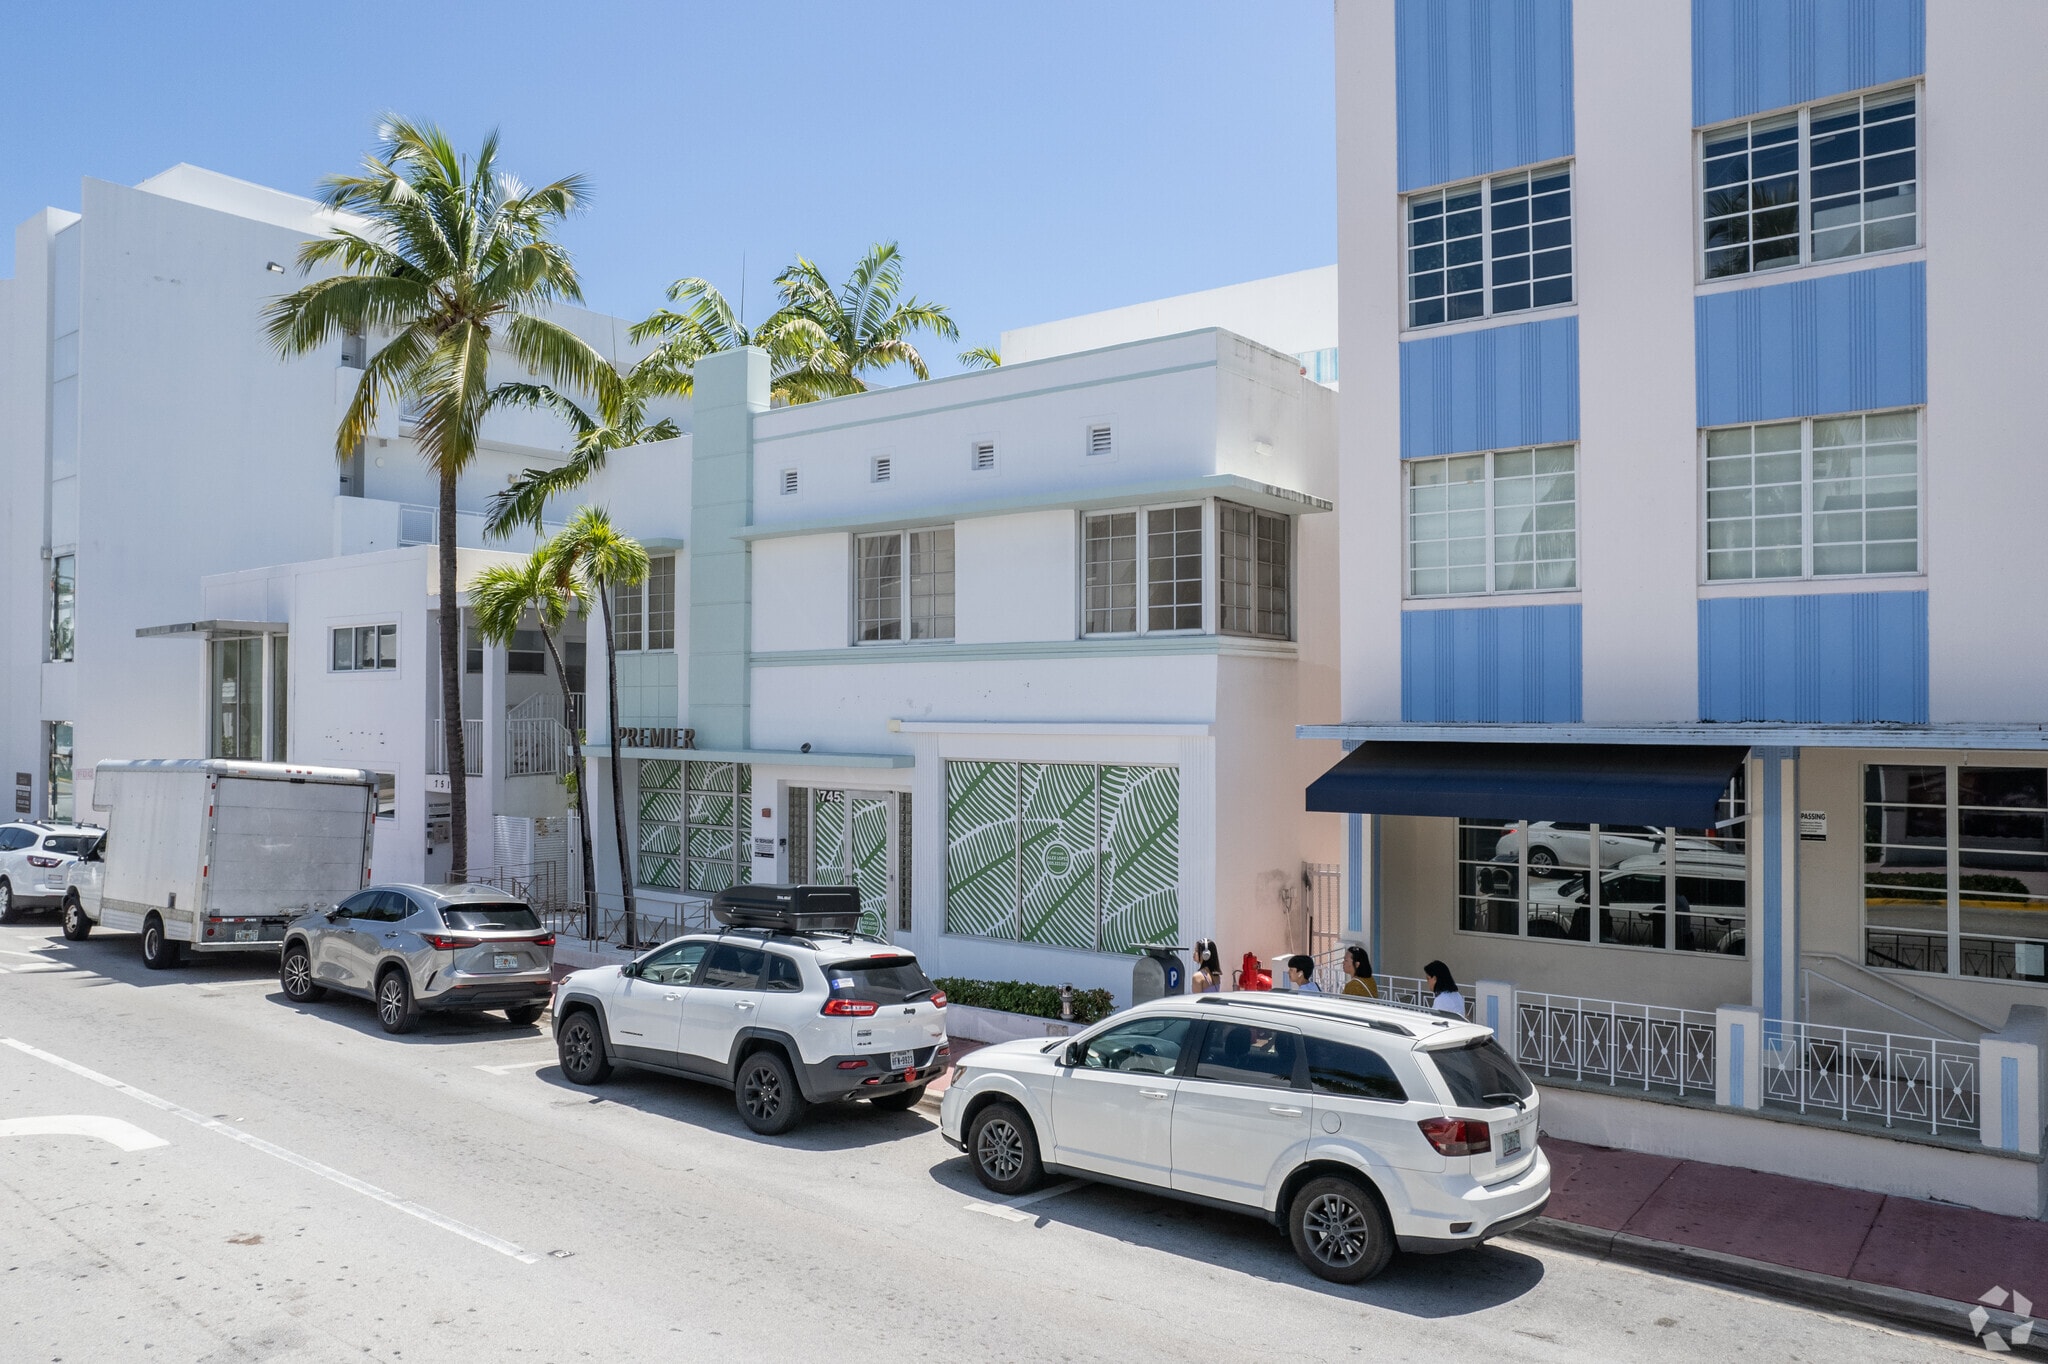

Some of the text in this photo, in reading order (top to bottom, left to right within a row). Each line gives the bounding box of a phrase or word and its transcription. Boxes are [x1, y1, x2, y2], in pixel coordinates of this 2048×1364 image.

[618, 727, 698, 750] PREMIER
[434, 779, 450, 789] 751
[820, 790, 842, 802] 745
[1800, 812, 1826, 820] PASSING
[1170, 971, 1178, 987] P
